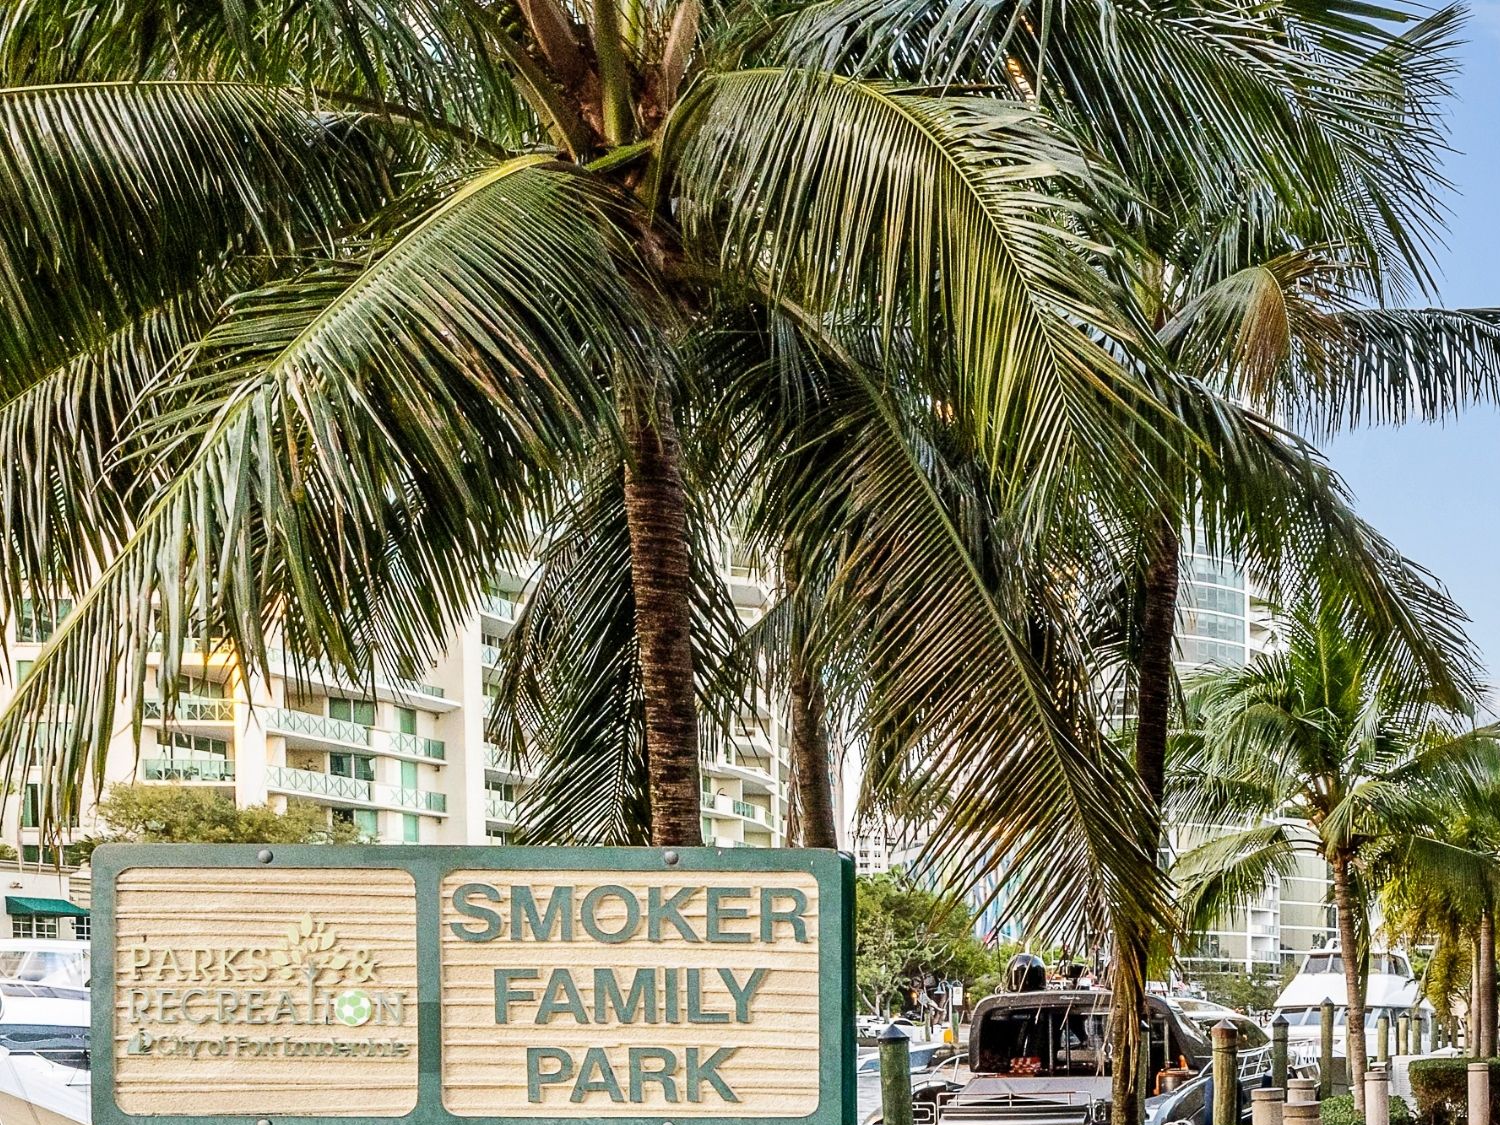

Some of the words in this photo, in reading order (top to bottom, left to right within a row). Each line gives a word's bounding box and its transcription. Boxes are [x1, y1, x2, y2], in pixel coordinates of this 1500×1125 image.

[449, 882, 810, 944] SMOKER
[127, 948, 269, 983] PARKS
[353, 949, 379, 983] &
[494, 967, 771, 1026] FAMILY
[159, 1035, 201, 1060] City
[207, 1035, 230, 1057] of
[235, 1036, 281, 1057] Fort
[526, 1047, 742, 1104] PARK
